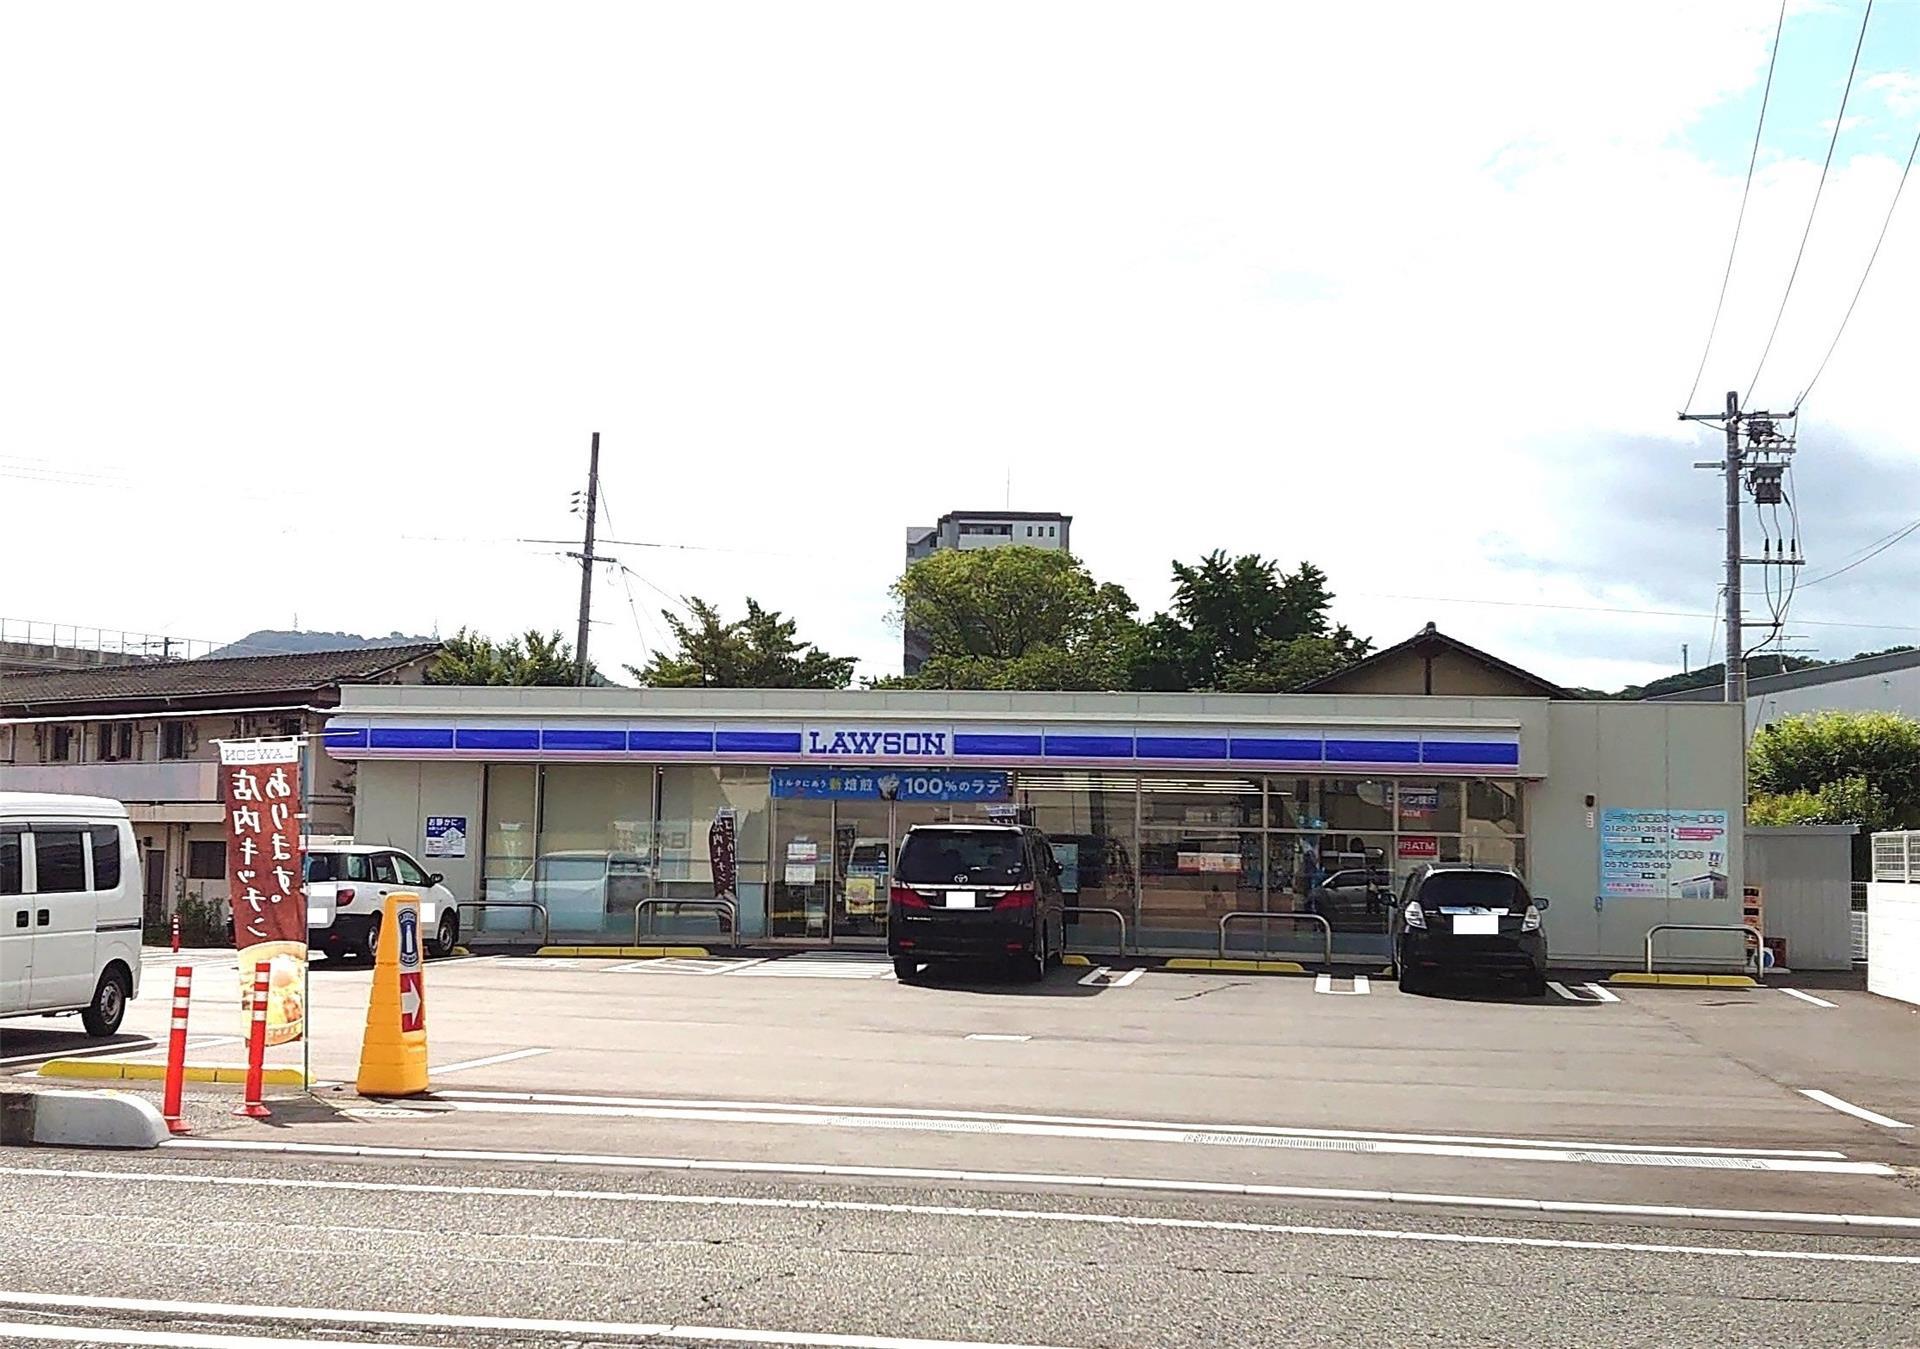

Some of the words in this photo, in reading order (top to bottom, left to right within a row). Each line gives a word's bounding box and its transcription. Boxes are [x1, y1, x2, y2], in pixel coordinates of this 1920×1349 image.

[808, 731, 946, 755] LAWSON
[904, 777, 1002, 795] 100%のラテ
